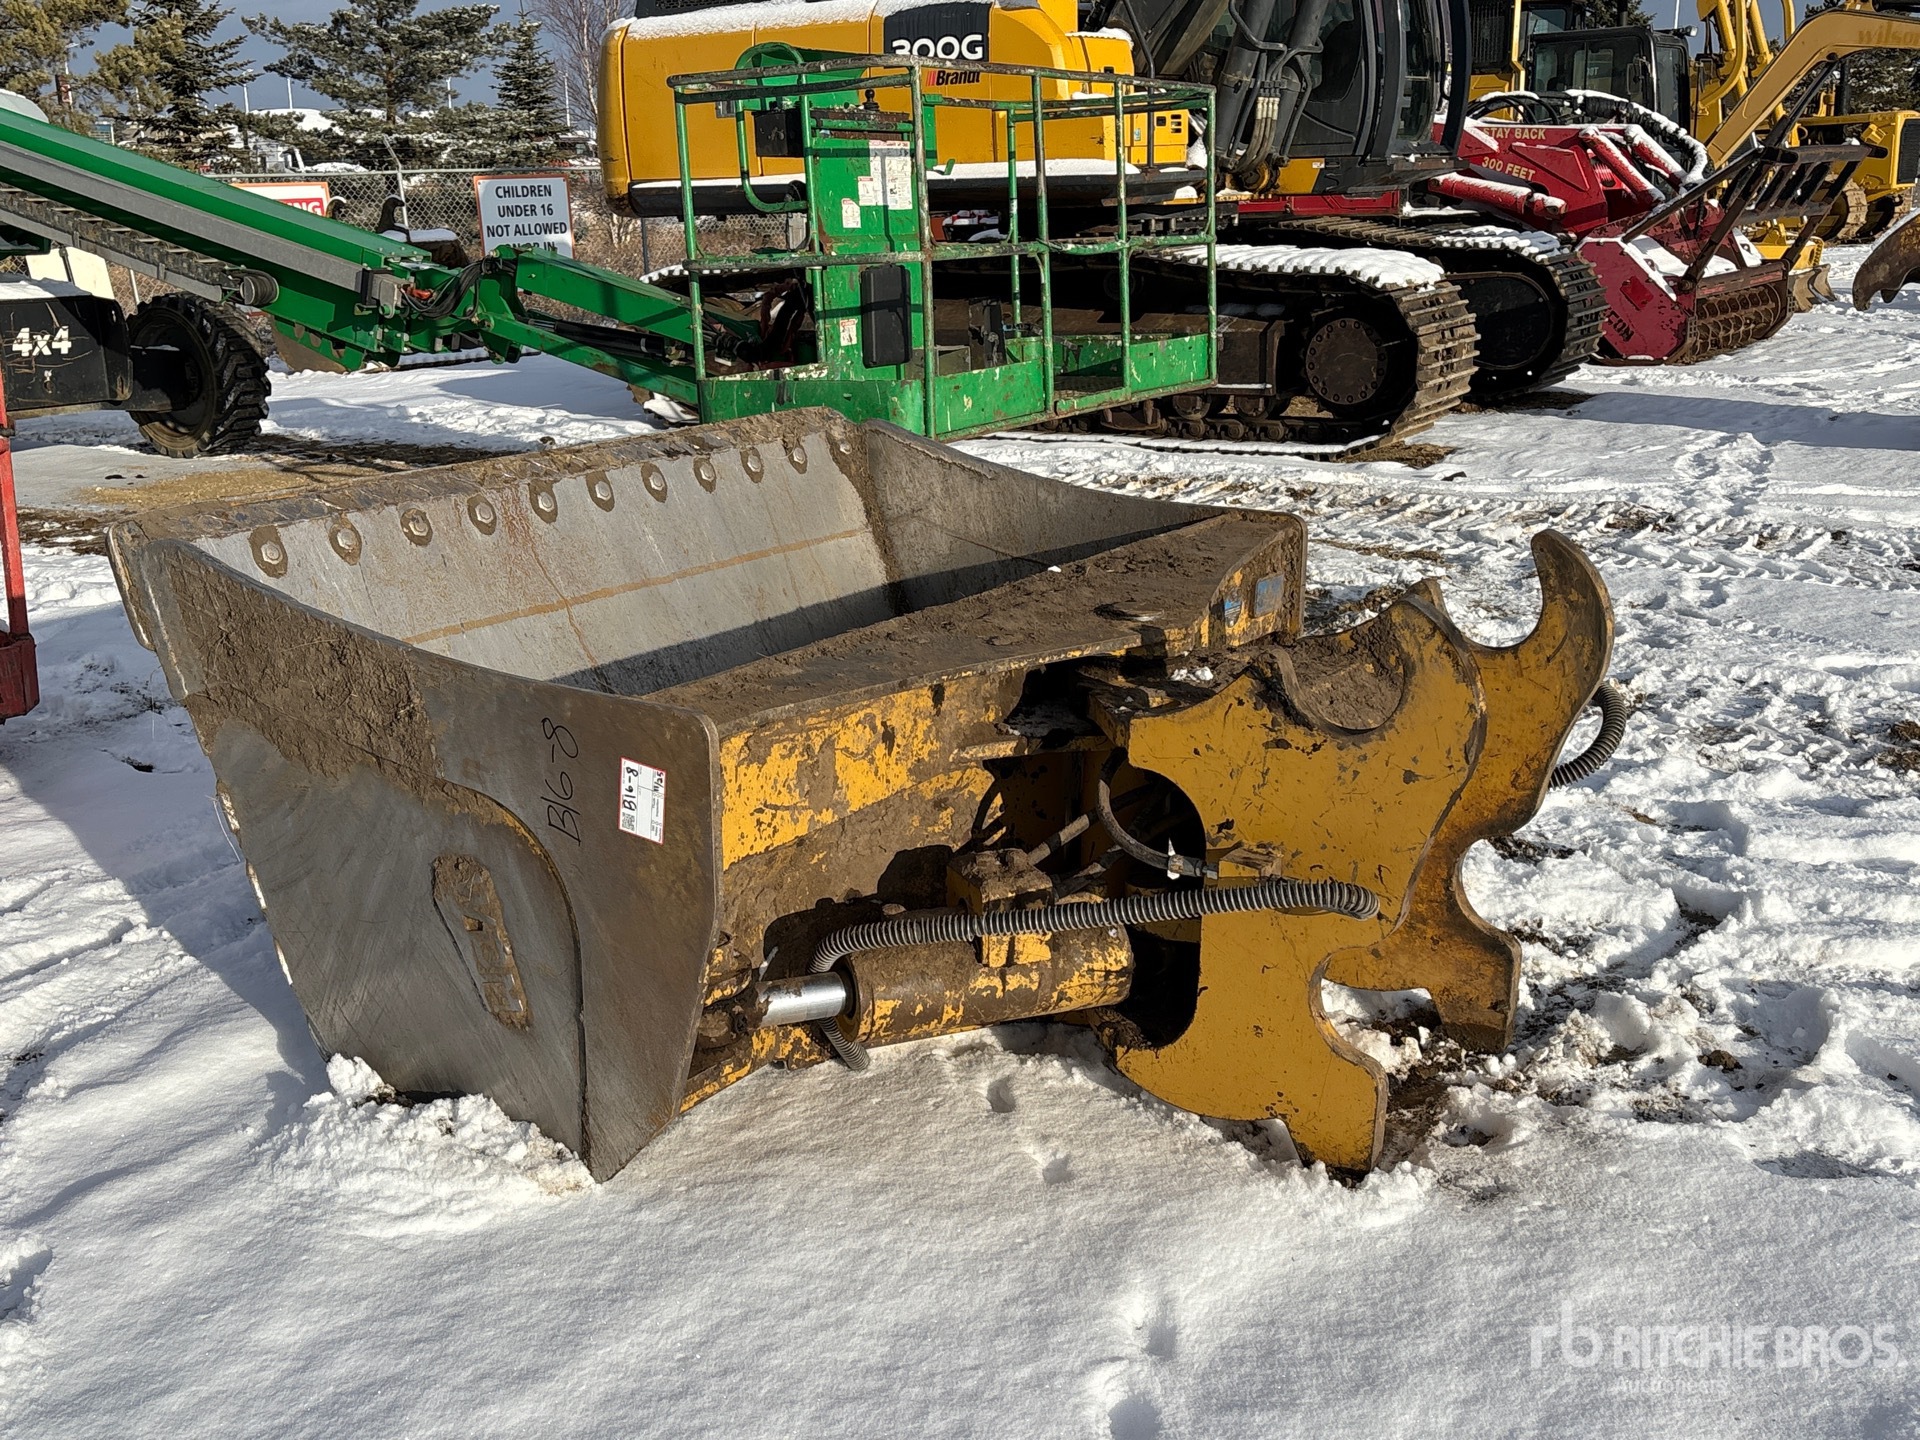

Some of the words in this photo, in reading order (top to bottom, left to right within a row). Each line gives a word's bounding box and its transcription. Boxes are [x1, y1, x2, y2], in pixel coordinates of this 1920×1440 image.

[892, 34, 983, 60] 300G
[936, 70, 980, 86] Brandt
[1483, 128, 1510, 139] STAY
[1514, 129, 1546, 140] BACK
[1482, 156, 1503, 172] 300
[1505, 163, 1536, 181] FEET
[495, 185, 552, 199] CHILDREN
[497, 204, 537, 218] UNDER
[540, 203, 554, 216] 16
[486, 224, 511, 238] NOT
[513, 221, 568, 237] ALLOWED
[12, 325, 72, 357] 4x4
[541, 717, 581, 847] B16-8
[622, 766, 639, 811] B16-8
